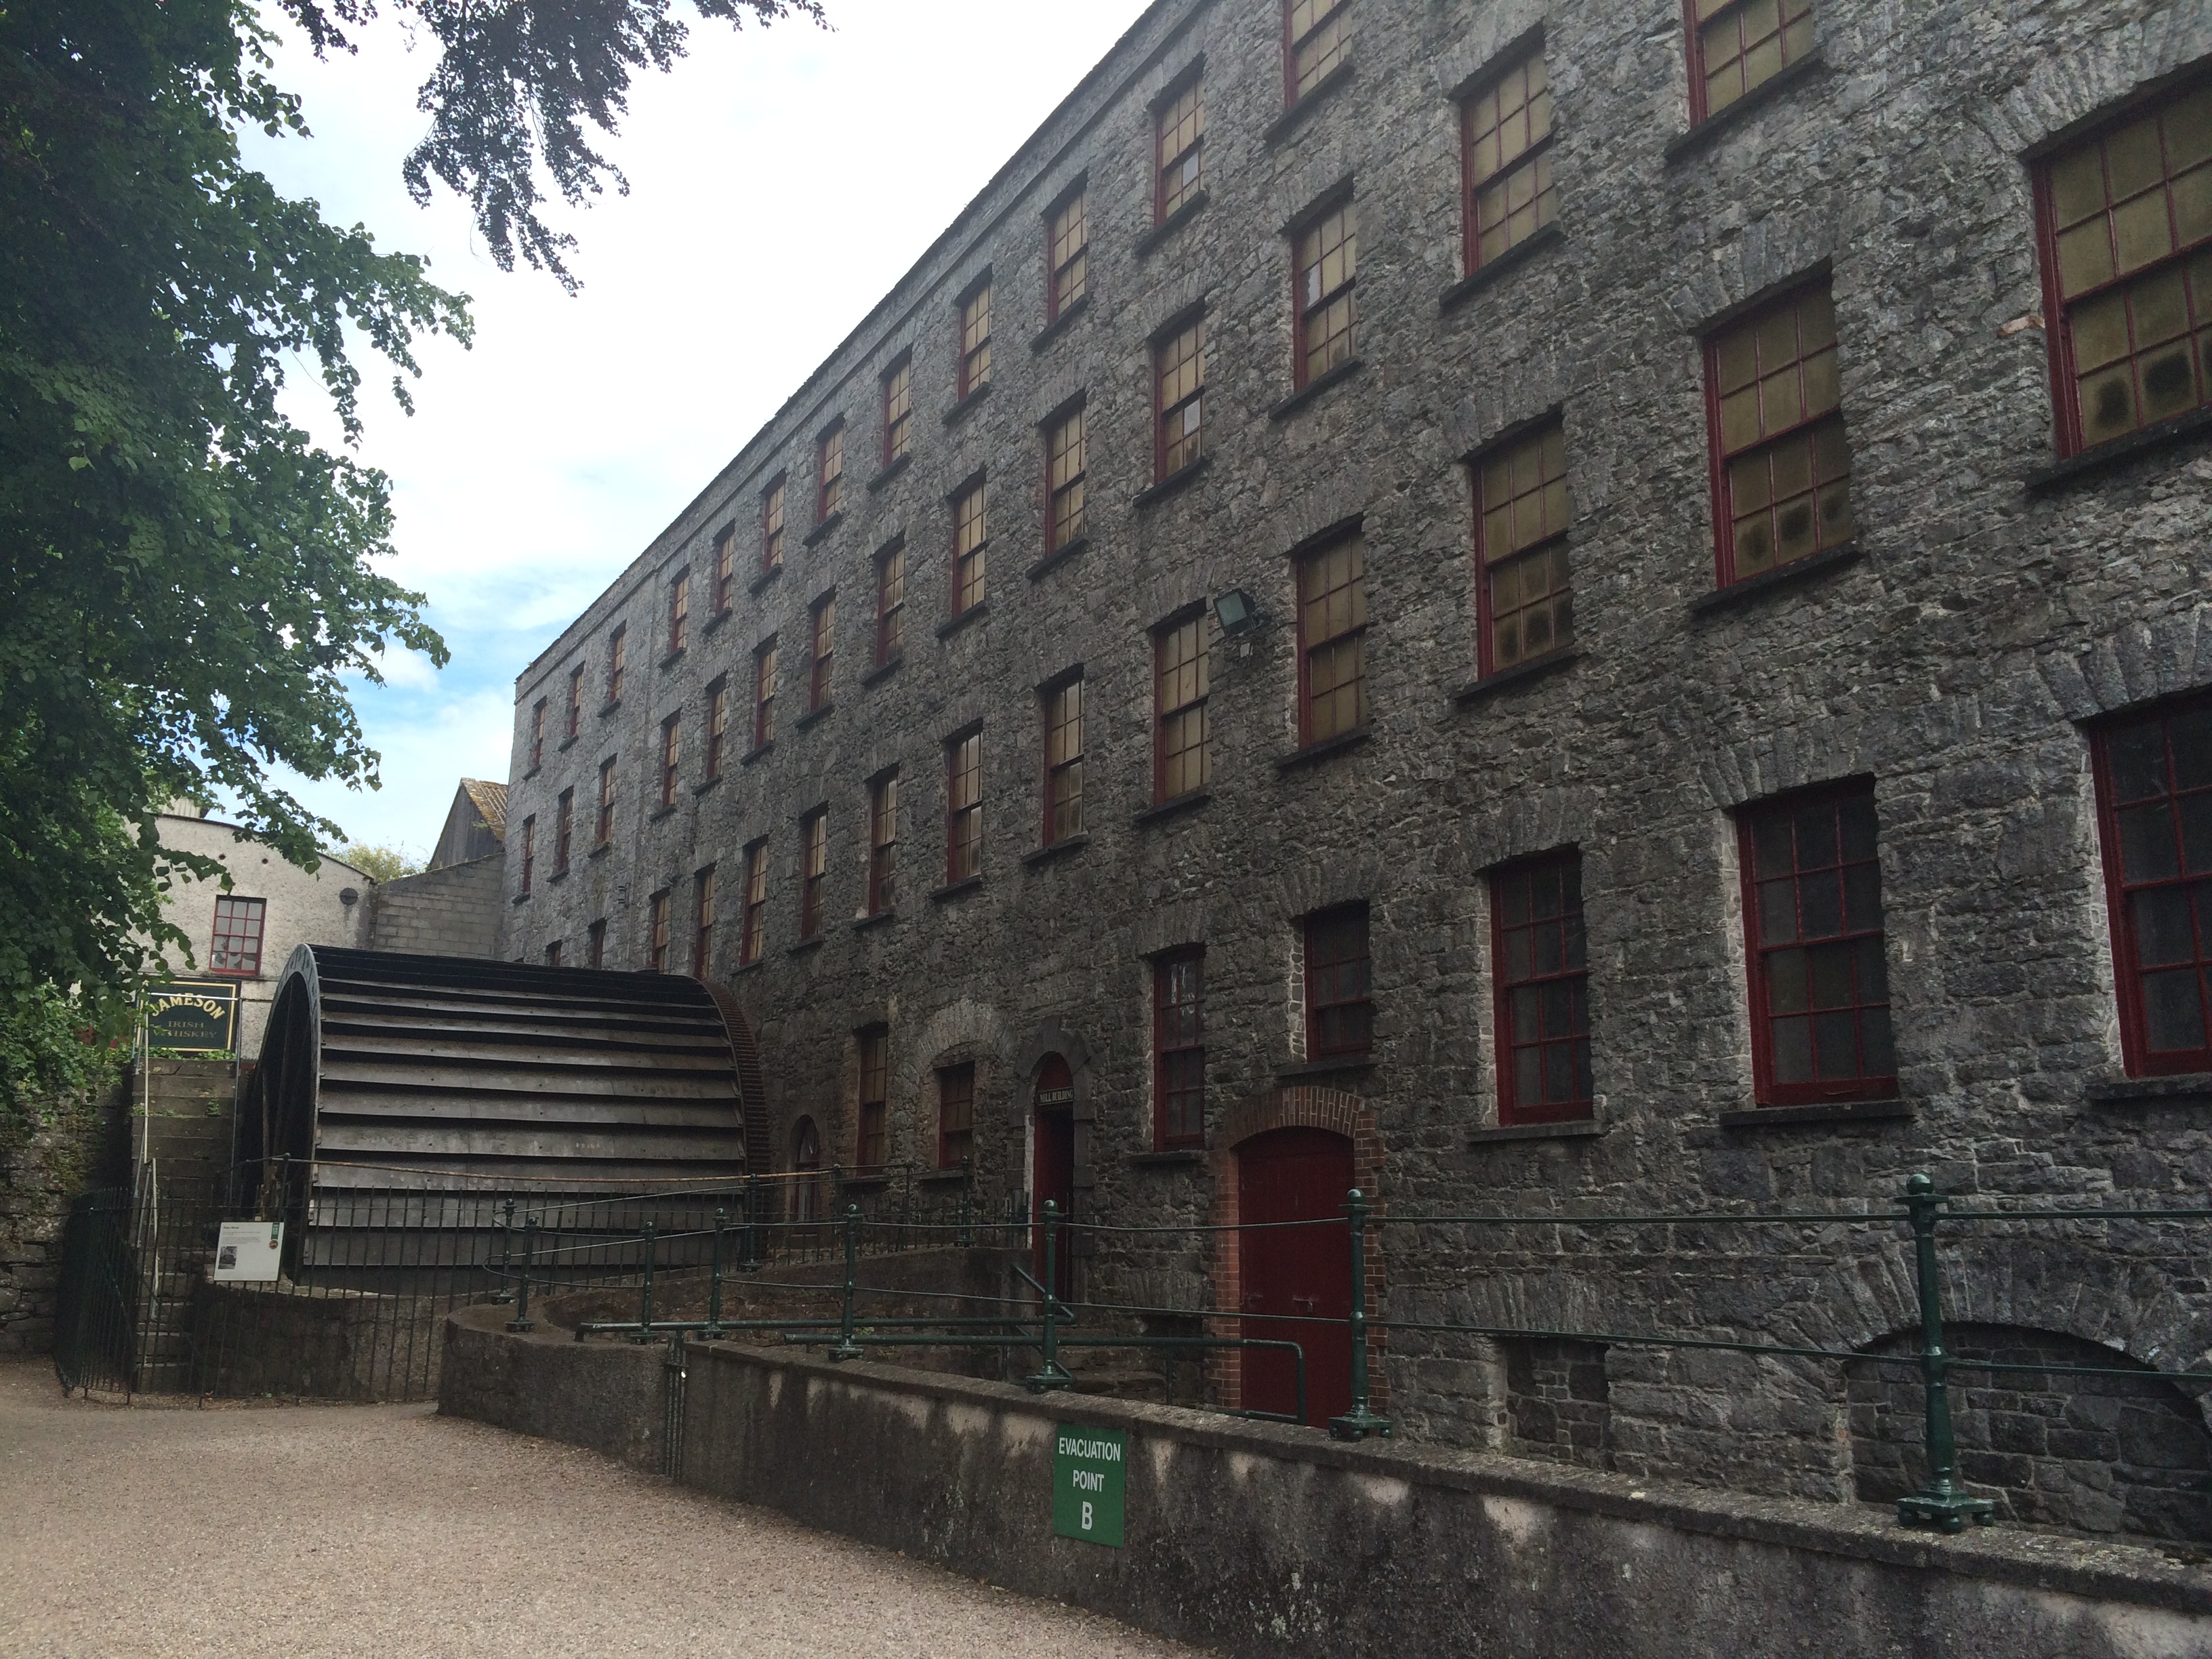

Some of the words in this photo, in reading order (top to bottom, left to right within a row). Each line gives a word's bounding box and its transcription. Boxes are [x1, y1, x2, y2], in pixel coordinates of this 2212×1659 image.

[150, 993, 226, 1020] JAMESON
[1040, 1093, 1051, 1103] MILL
[1052, 1090, 1073, 1101] BUILDING
[1059, 1437, 1121, 1462] EVACUATION
[1073, 1469, 1105, 1492] POINT
[1082, 1501, 1092, 1530] B
